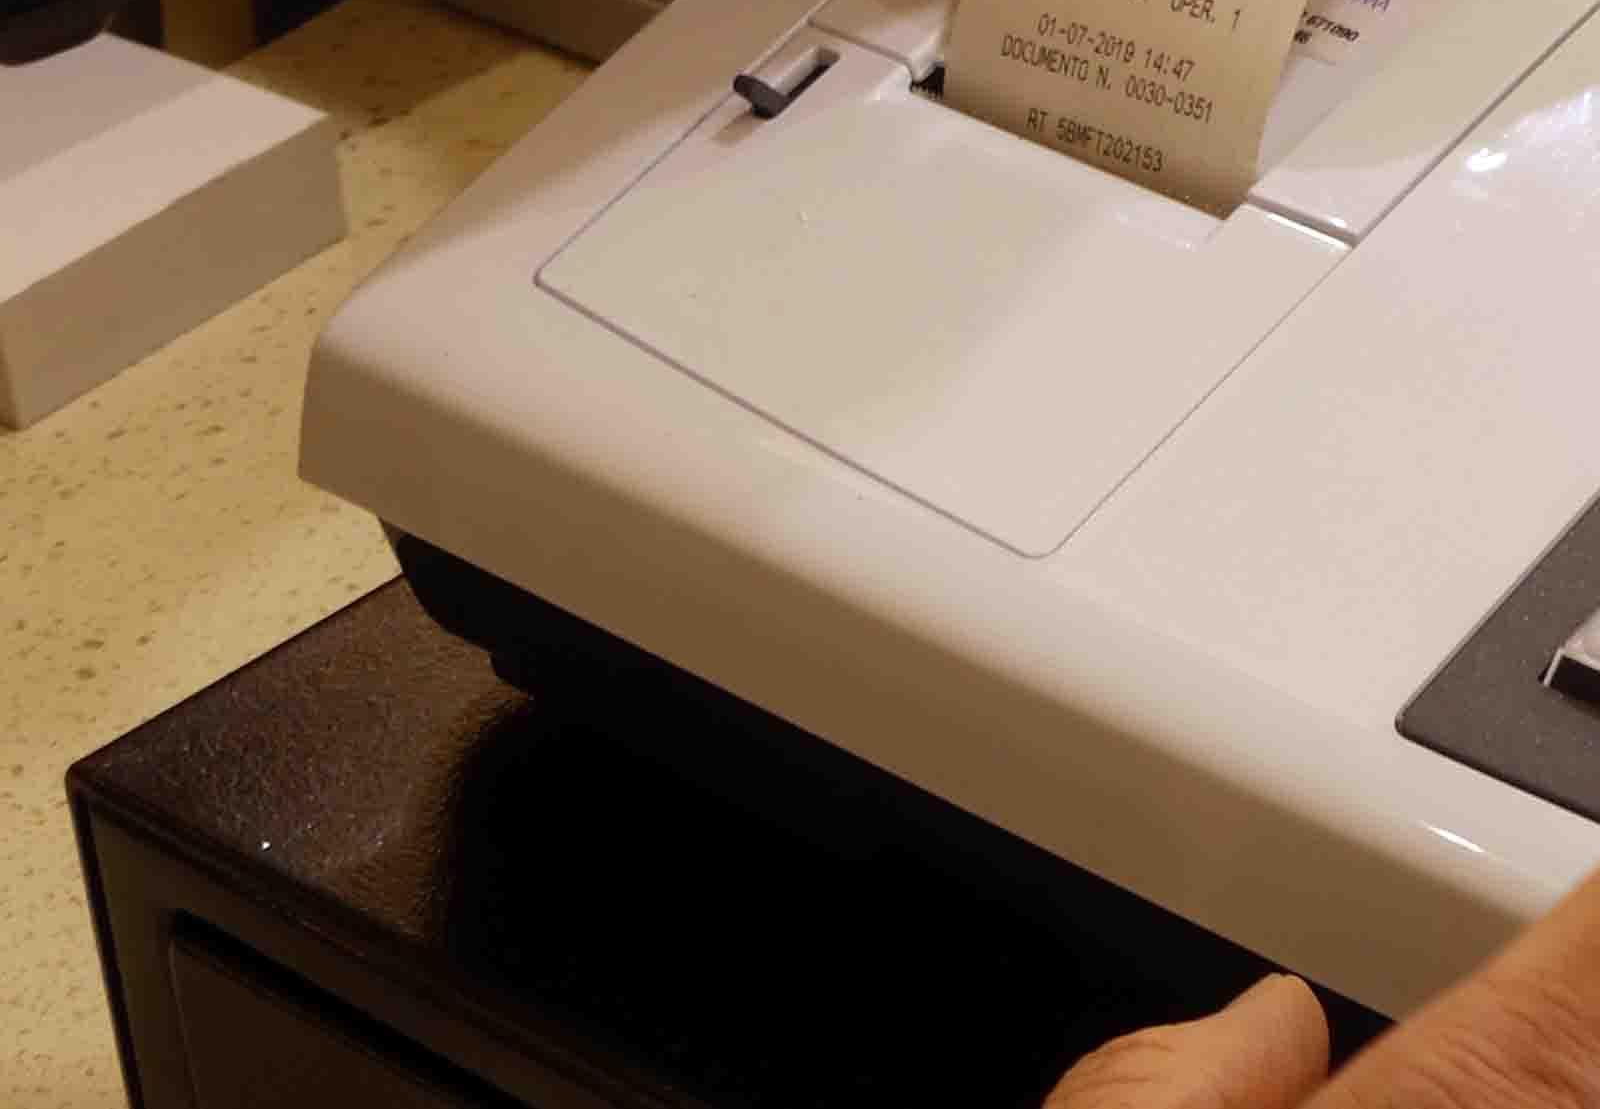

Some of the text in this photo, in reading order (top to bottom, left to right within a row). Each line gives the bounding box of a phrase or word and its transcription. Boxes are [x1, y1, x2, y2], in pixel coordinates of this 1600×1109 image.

[1232, 10, 1241, 28] 1
[1037, 13, 1196, 83] 01-07-2019 14:47
[1000, 34, 1214, 126] DOCUMENTO N. 0030-0351
[1025, 107, 1049, 133] RT
